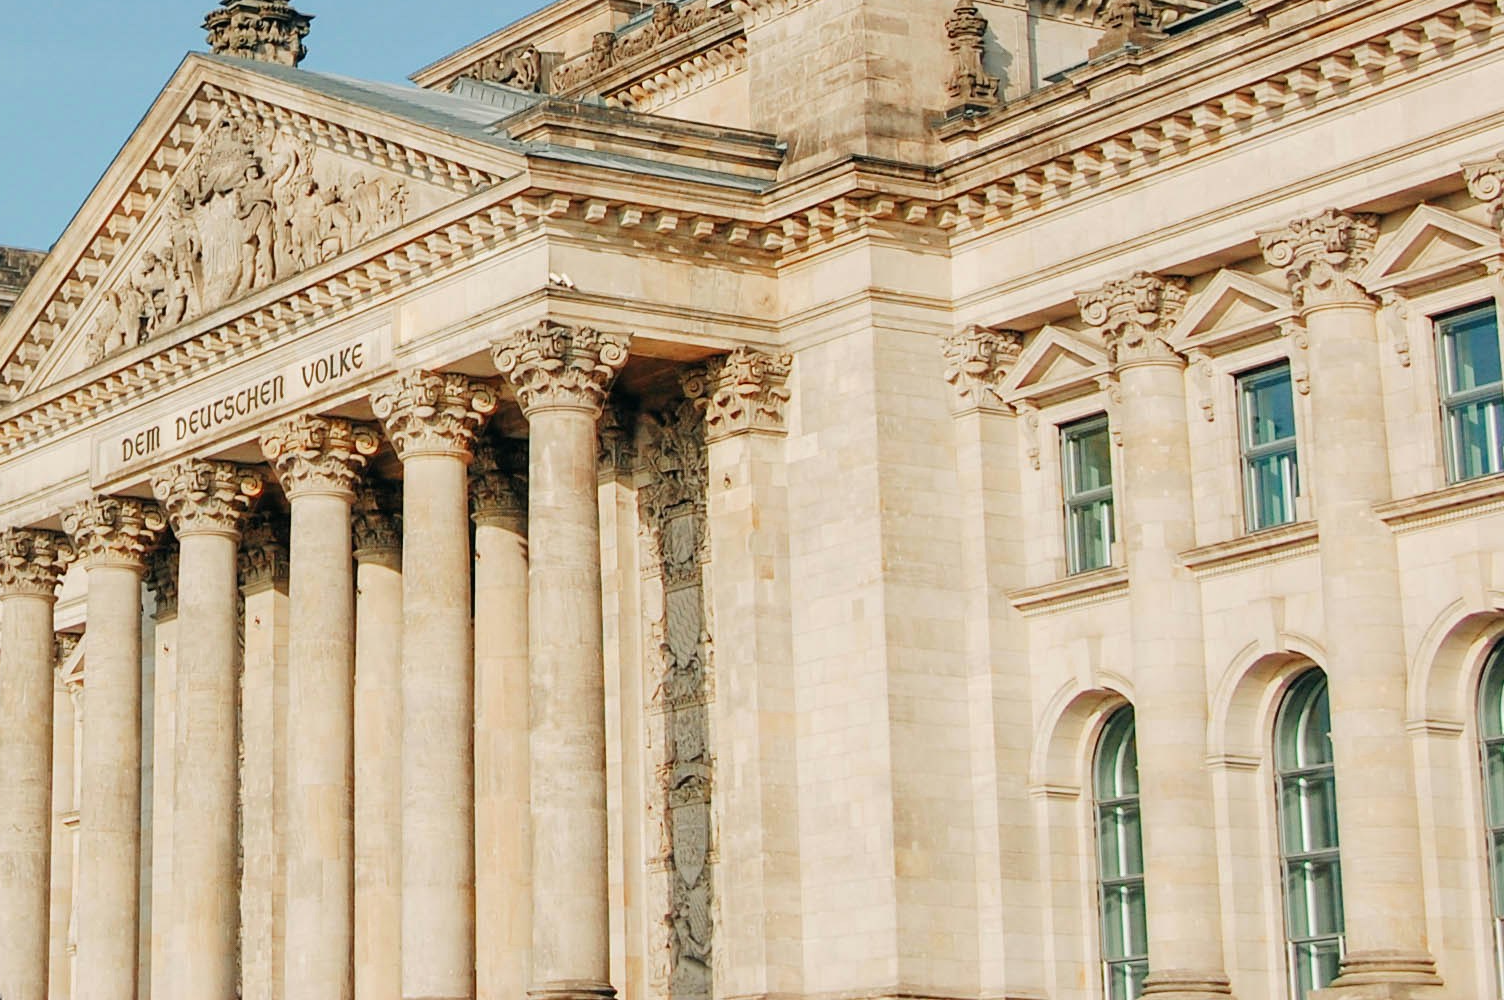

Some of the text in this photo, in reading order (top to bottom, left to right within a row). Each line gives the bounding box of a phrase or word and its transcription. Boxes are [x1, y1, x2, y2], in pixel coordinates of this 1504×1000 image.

[122, 343, 364, 462] DEM DEUTSCHEN VOLKE
